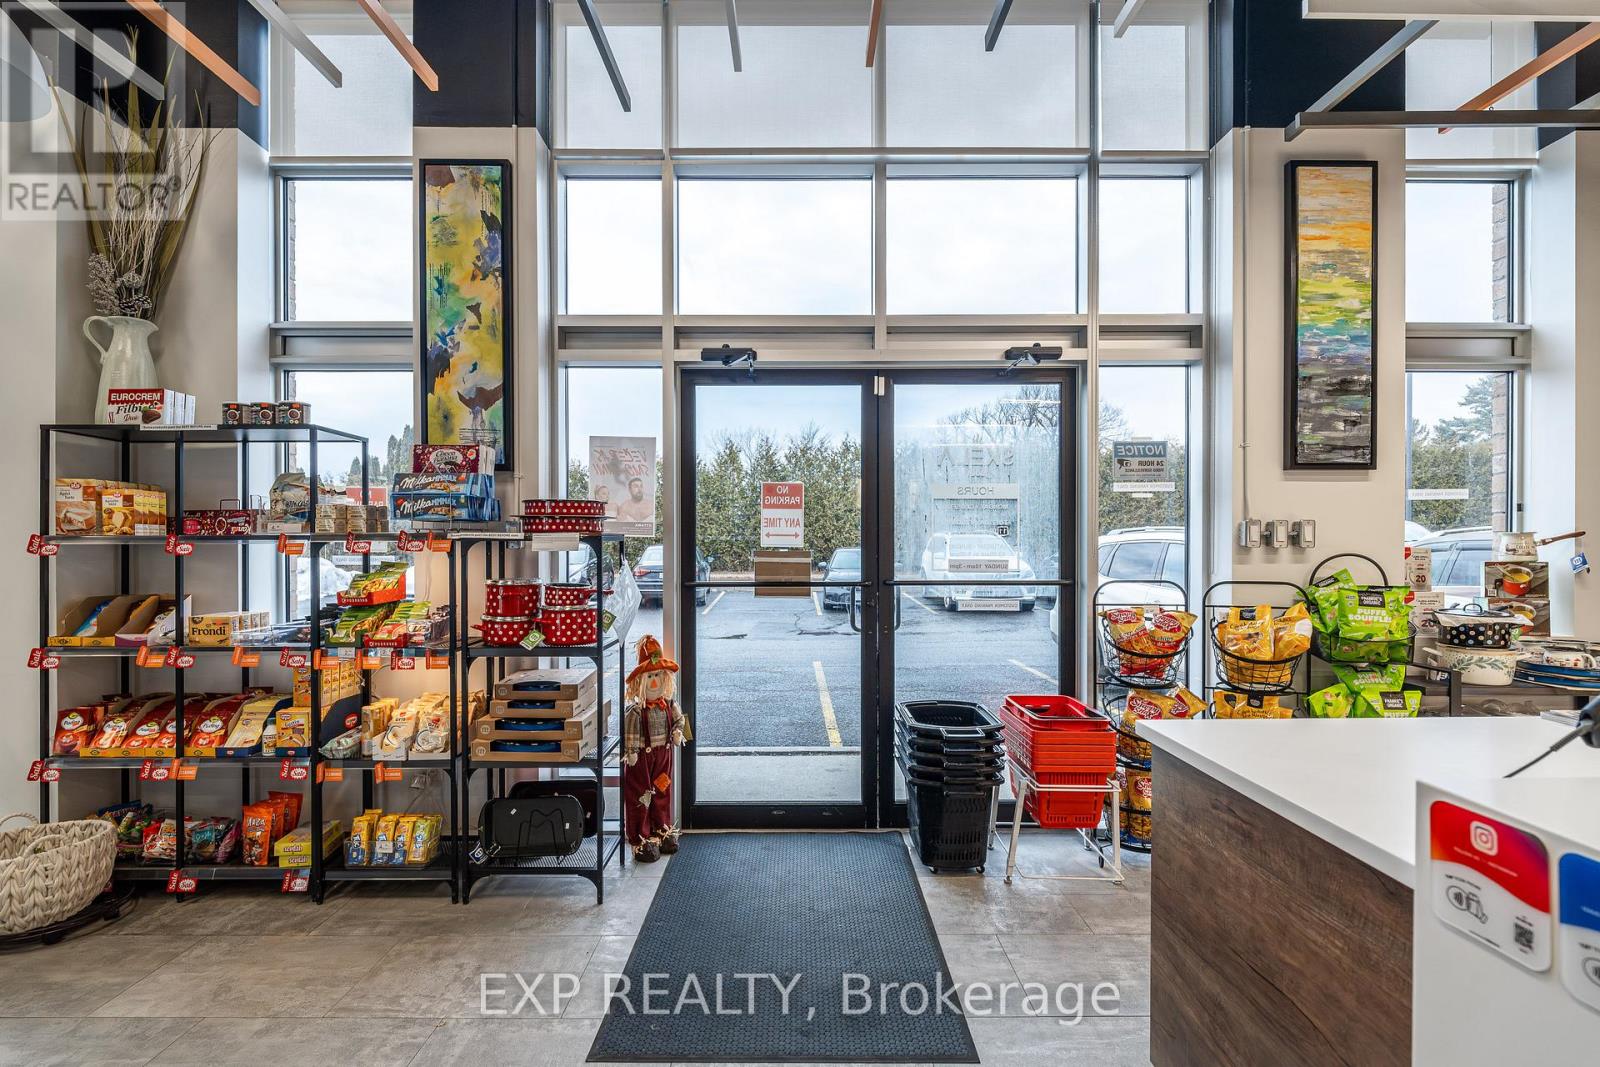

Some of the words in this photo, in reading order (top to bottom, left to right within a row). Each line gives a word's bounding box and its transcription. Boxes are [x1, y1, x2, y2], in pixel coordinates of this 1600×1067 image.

[111, 392, 160, 401] EUROCREM
[400, 473, 433, 488] Milka
[400, 499, 432, 514] Milka
[191, 626, 226, 636] Frondi
